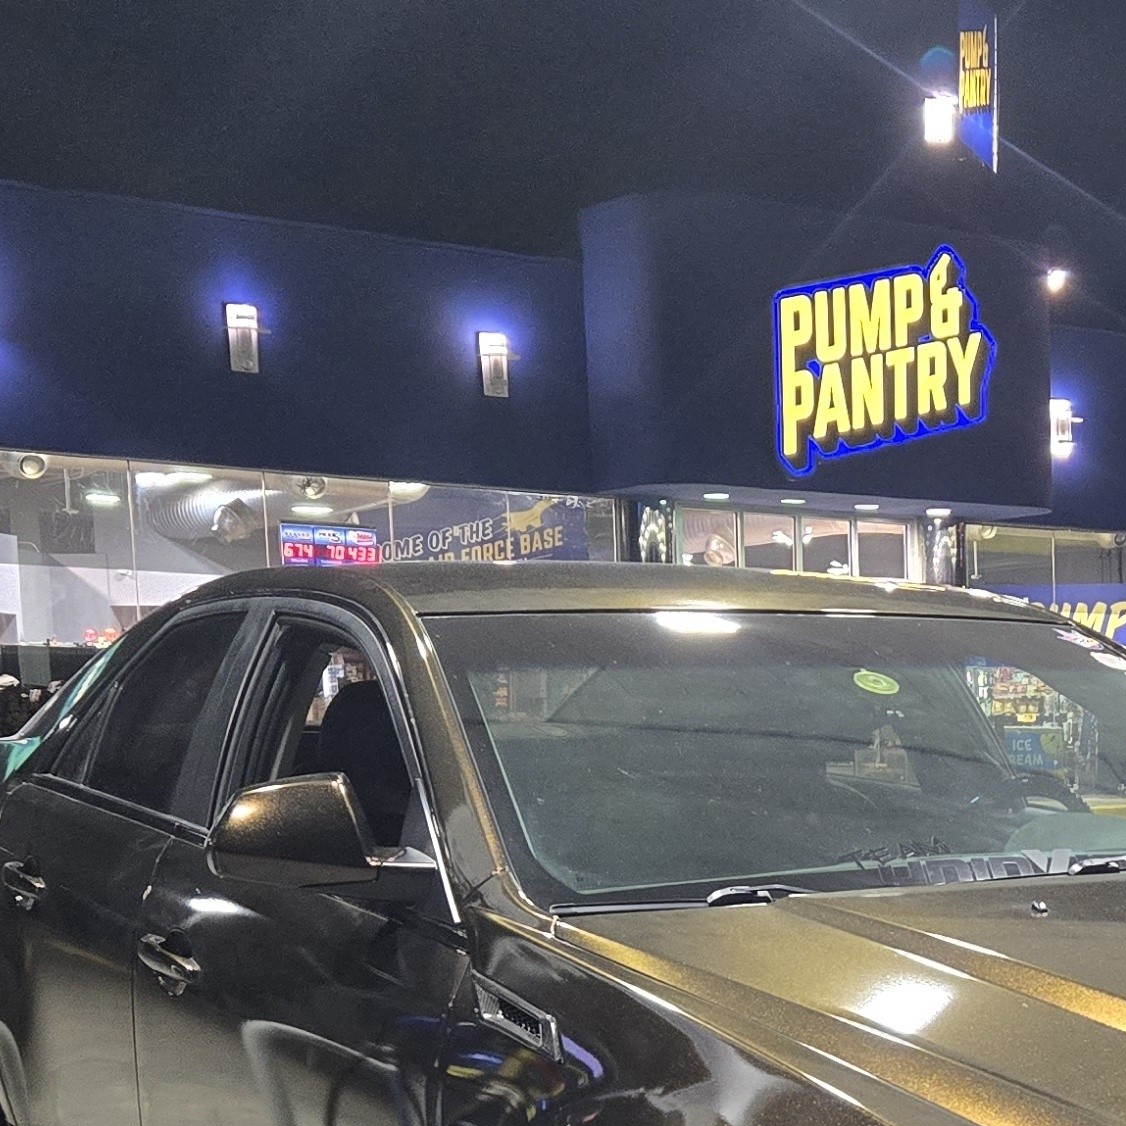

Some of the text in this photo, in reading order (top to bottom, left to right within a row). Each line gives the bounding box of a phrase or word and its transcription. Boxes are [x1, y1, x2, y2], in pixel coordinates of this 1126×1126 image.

[959, 68, 991, 114] PANTRY
[782, 331, 982, 456] PANTRY
[376, 534, 424, 563] OME
[428, 527, 453, 552] OF
[456, 518, 494, 545] THE
[461, 537, 515, 561] FORCE
[519, 525, 564, 555] BASE
[1008, 754, 1044, 766] REAM
[1012, 739, 1032, 752] ICE
